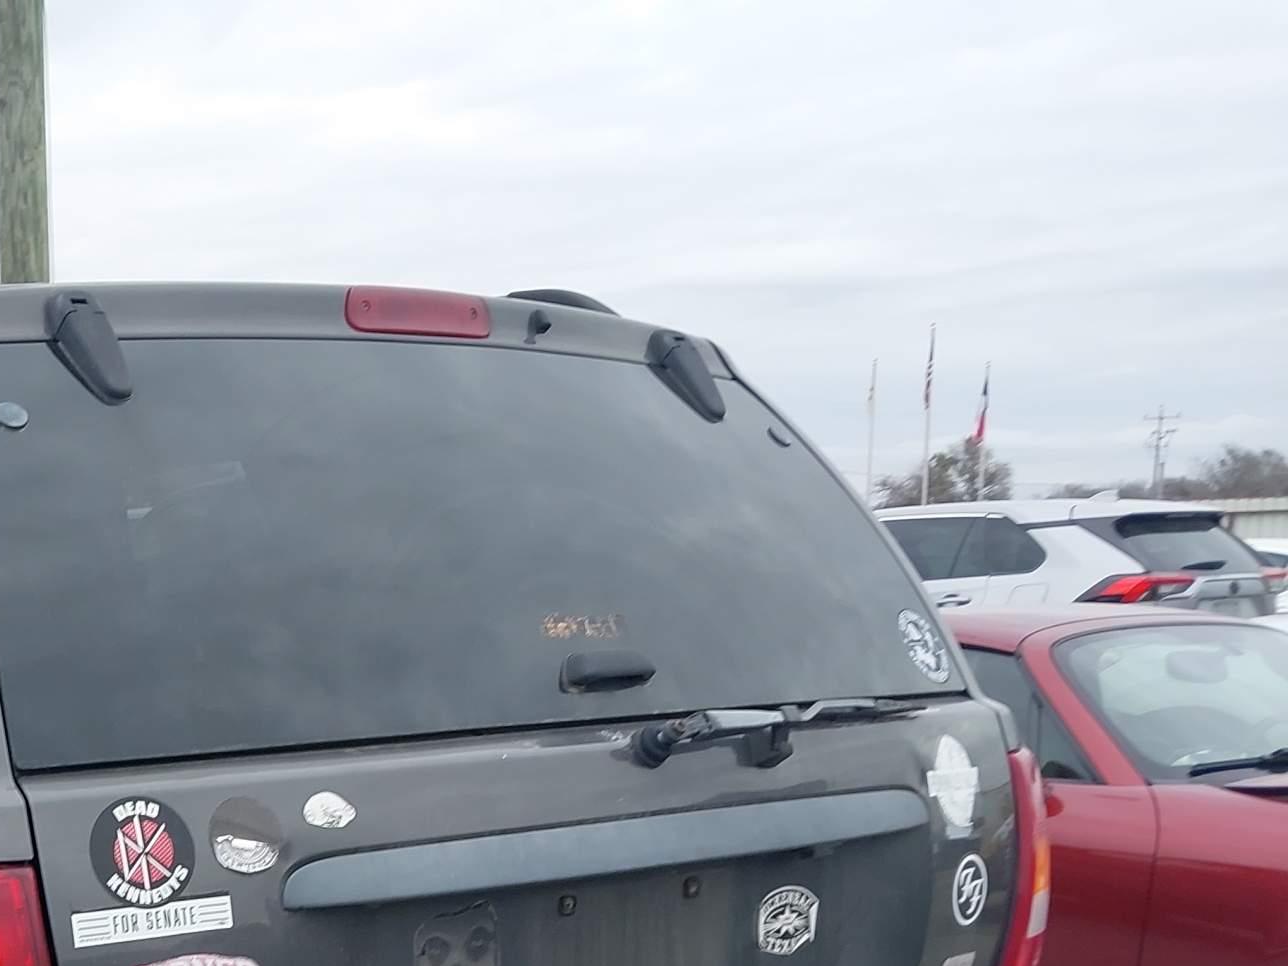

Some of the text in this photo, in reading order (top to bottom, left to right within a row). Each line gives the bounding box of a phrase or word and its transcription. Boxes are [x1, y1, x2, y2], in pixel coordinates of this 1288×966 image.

[112, 800, 160, 822] DEAD
[106, 864, 189, 905] KENNEDYS
[112, 905, 198, 936] FOR SENATE
